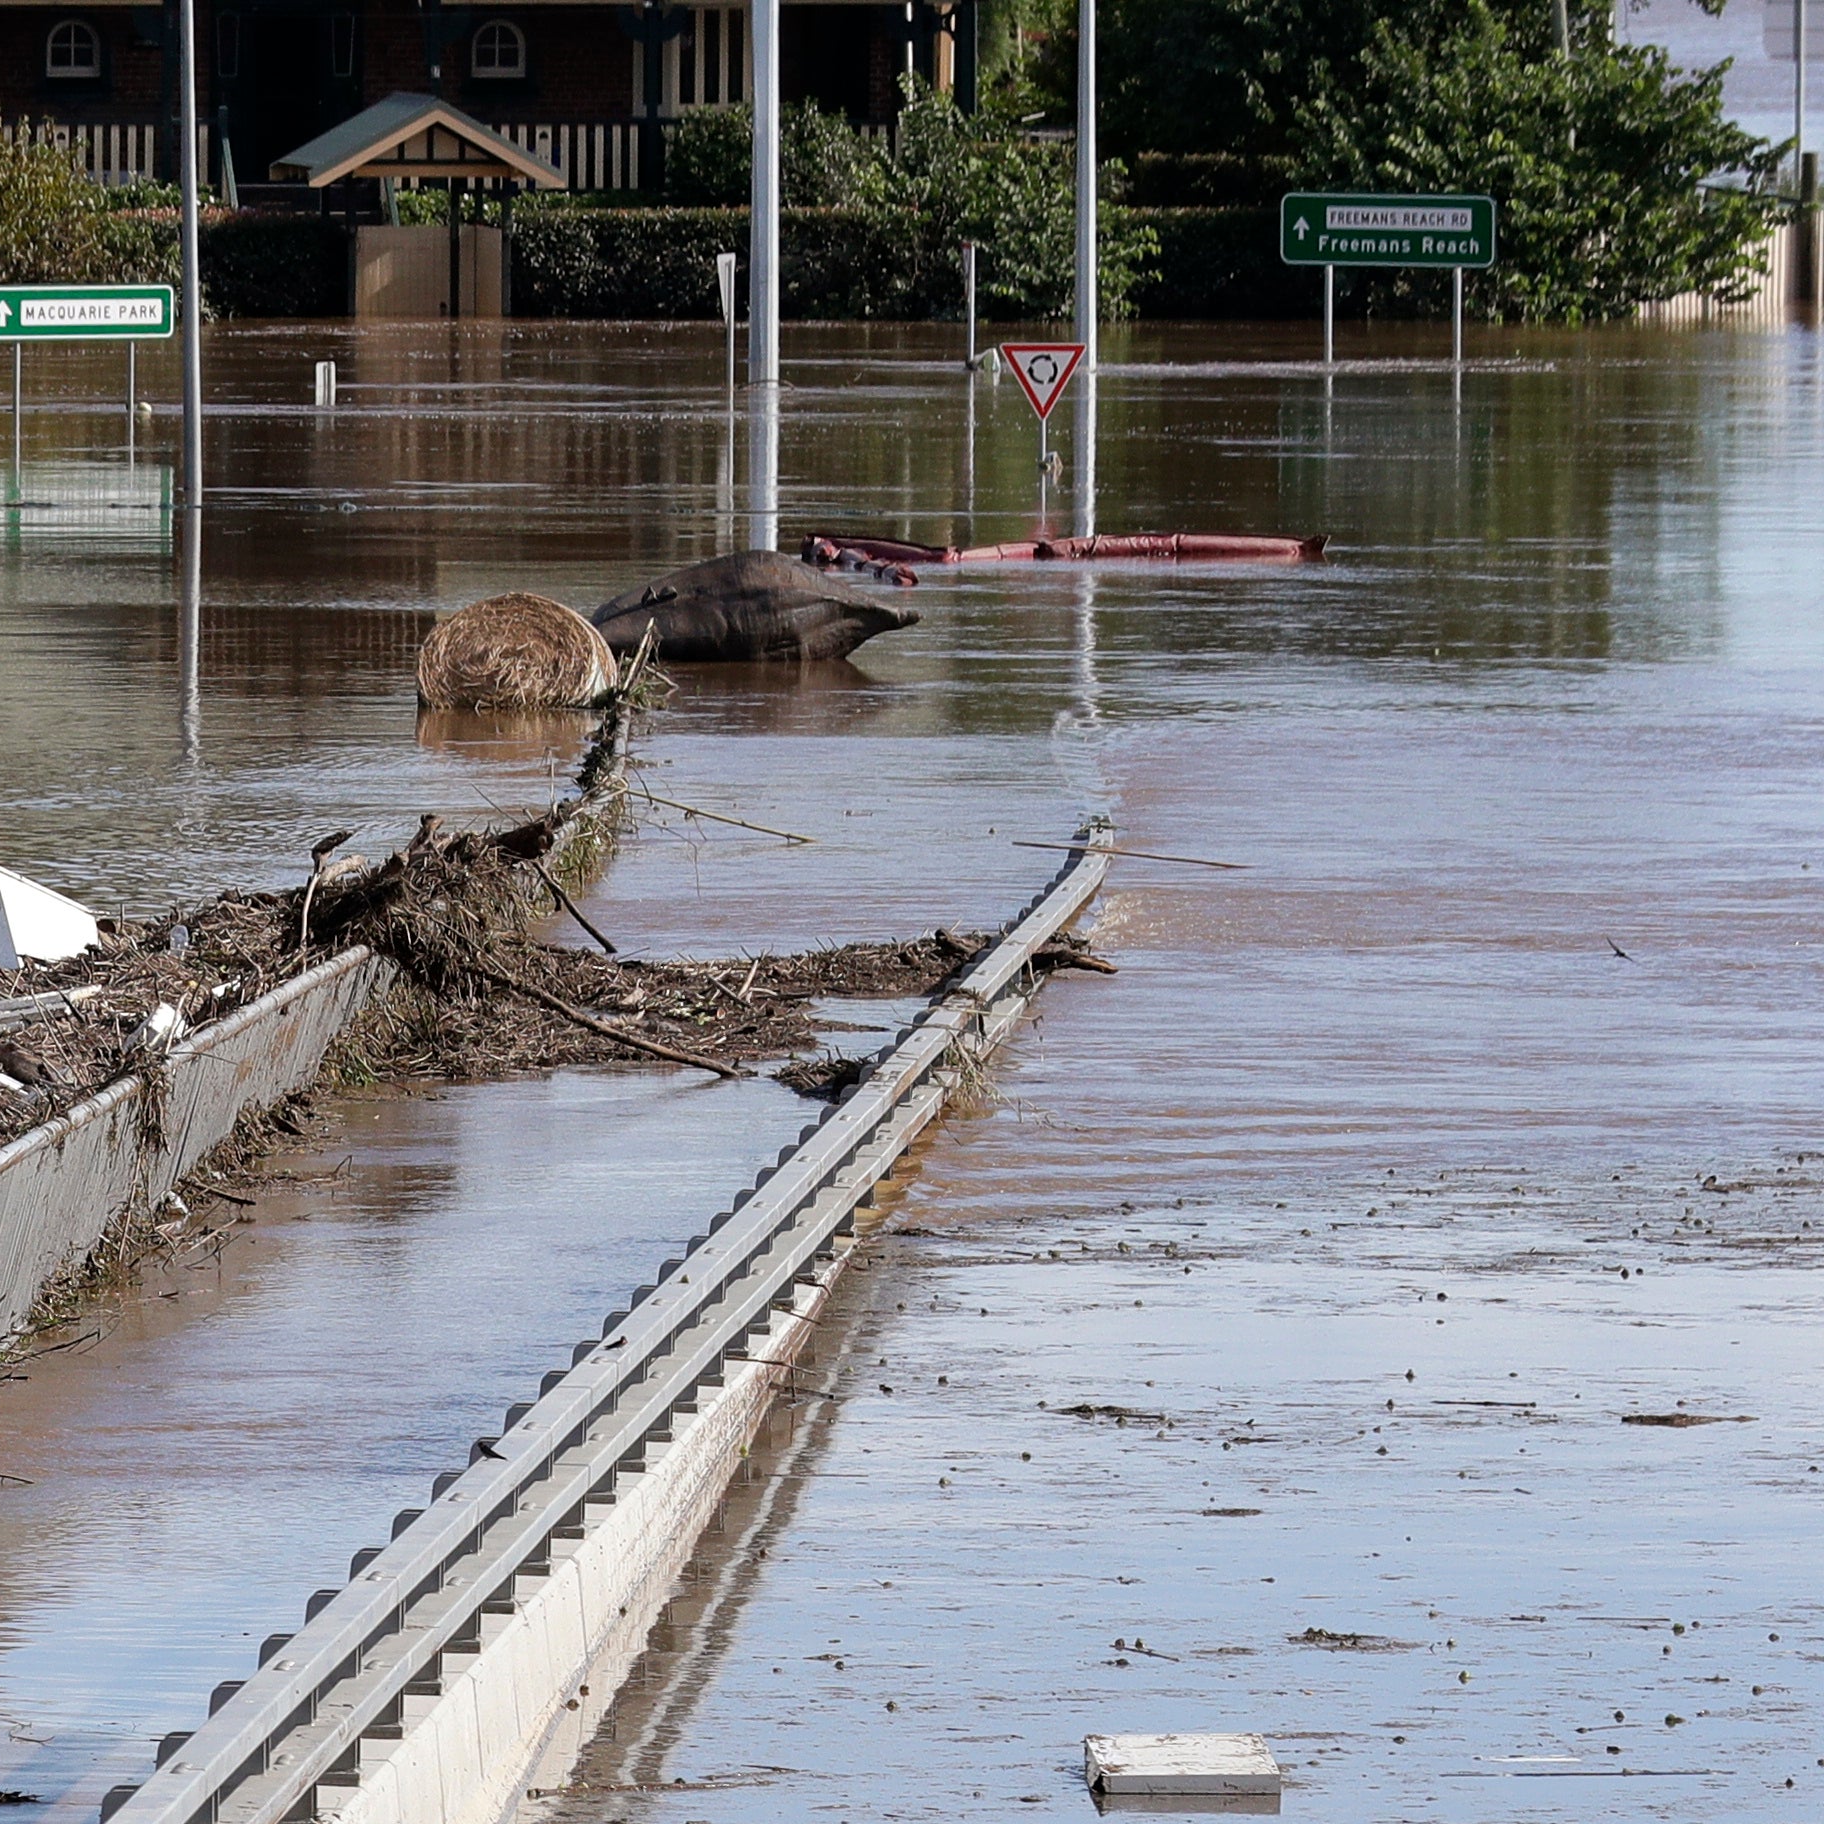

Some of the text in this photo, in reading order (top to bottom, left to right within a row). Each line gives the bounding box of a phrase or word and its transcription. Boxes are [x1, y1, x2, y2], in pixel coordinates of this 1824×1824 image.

[1330, 211, 1468, 226] FREEMANS REACH RD
[1318, 234, 1480, 255] Freemans Reach
[26, 304, 157, 320] MACQUARIE PARK
